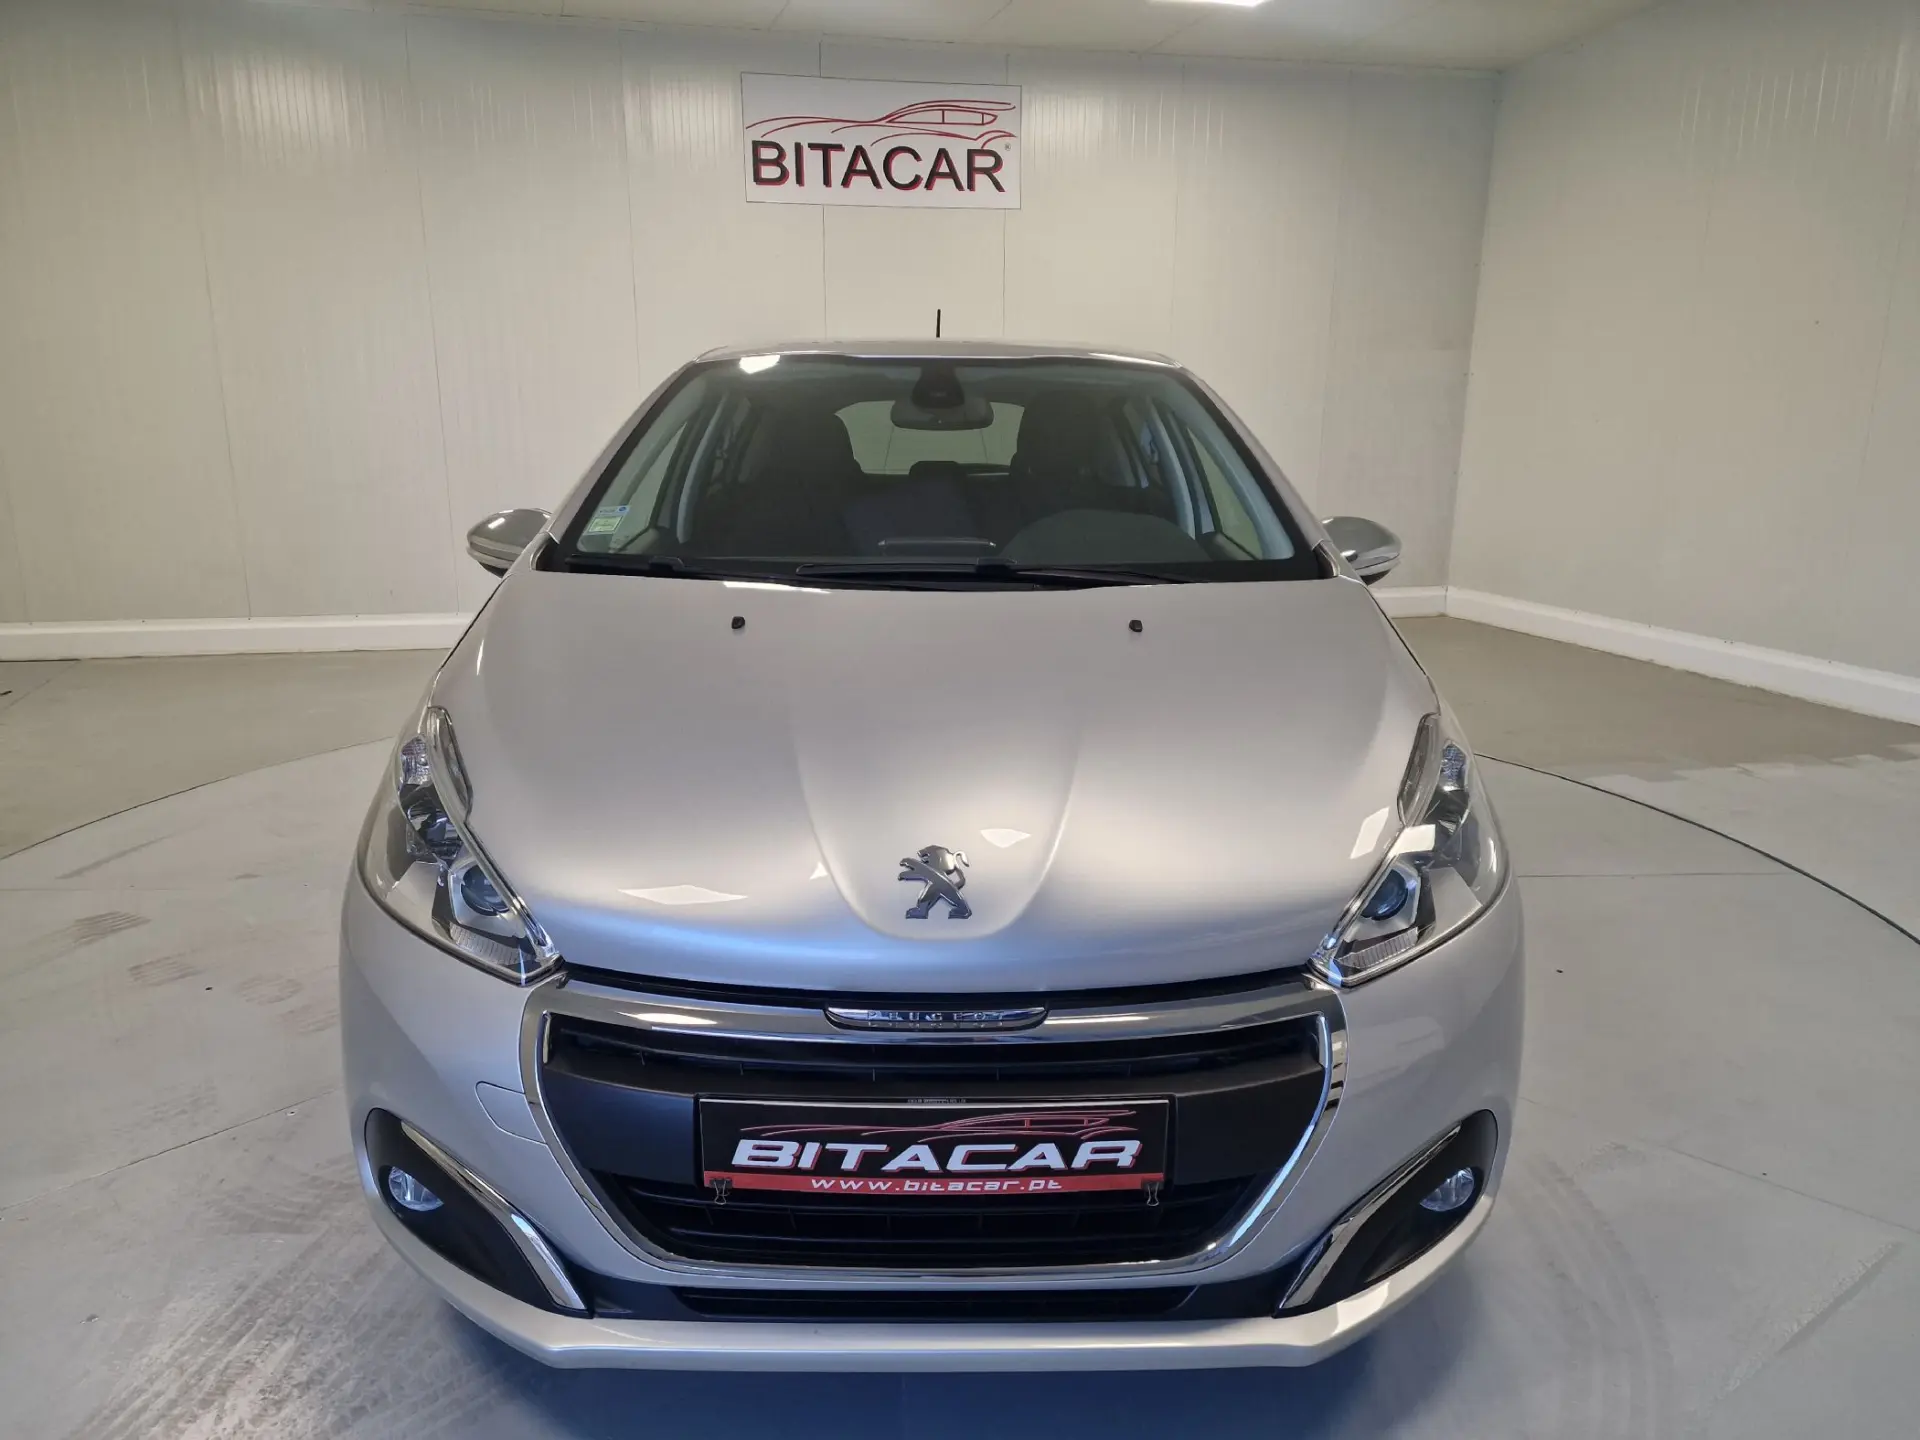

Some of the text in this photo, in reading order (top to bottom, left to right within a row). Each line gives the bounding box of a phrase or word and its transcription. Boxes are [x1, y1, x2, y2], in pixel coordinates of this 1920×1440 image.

[752, 140, 1005, 192] BITACAR
[731, 1139, 1142, 1173] BITACAR
[811, 1178, 1064, 1192] www.bitacar.pt
